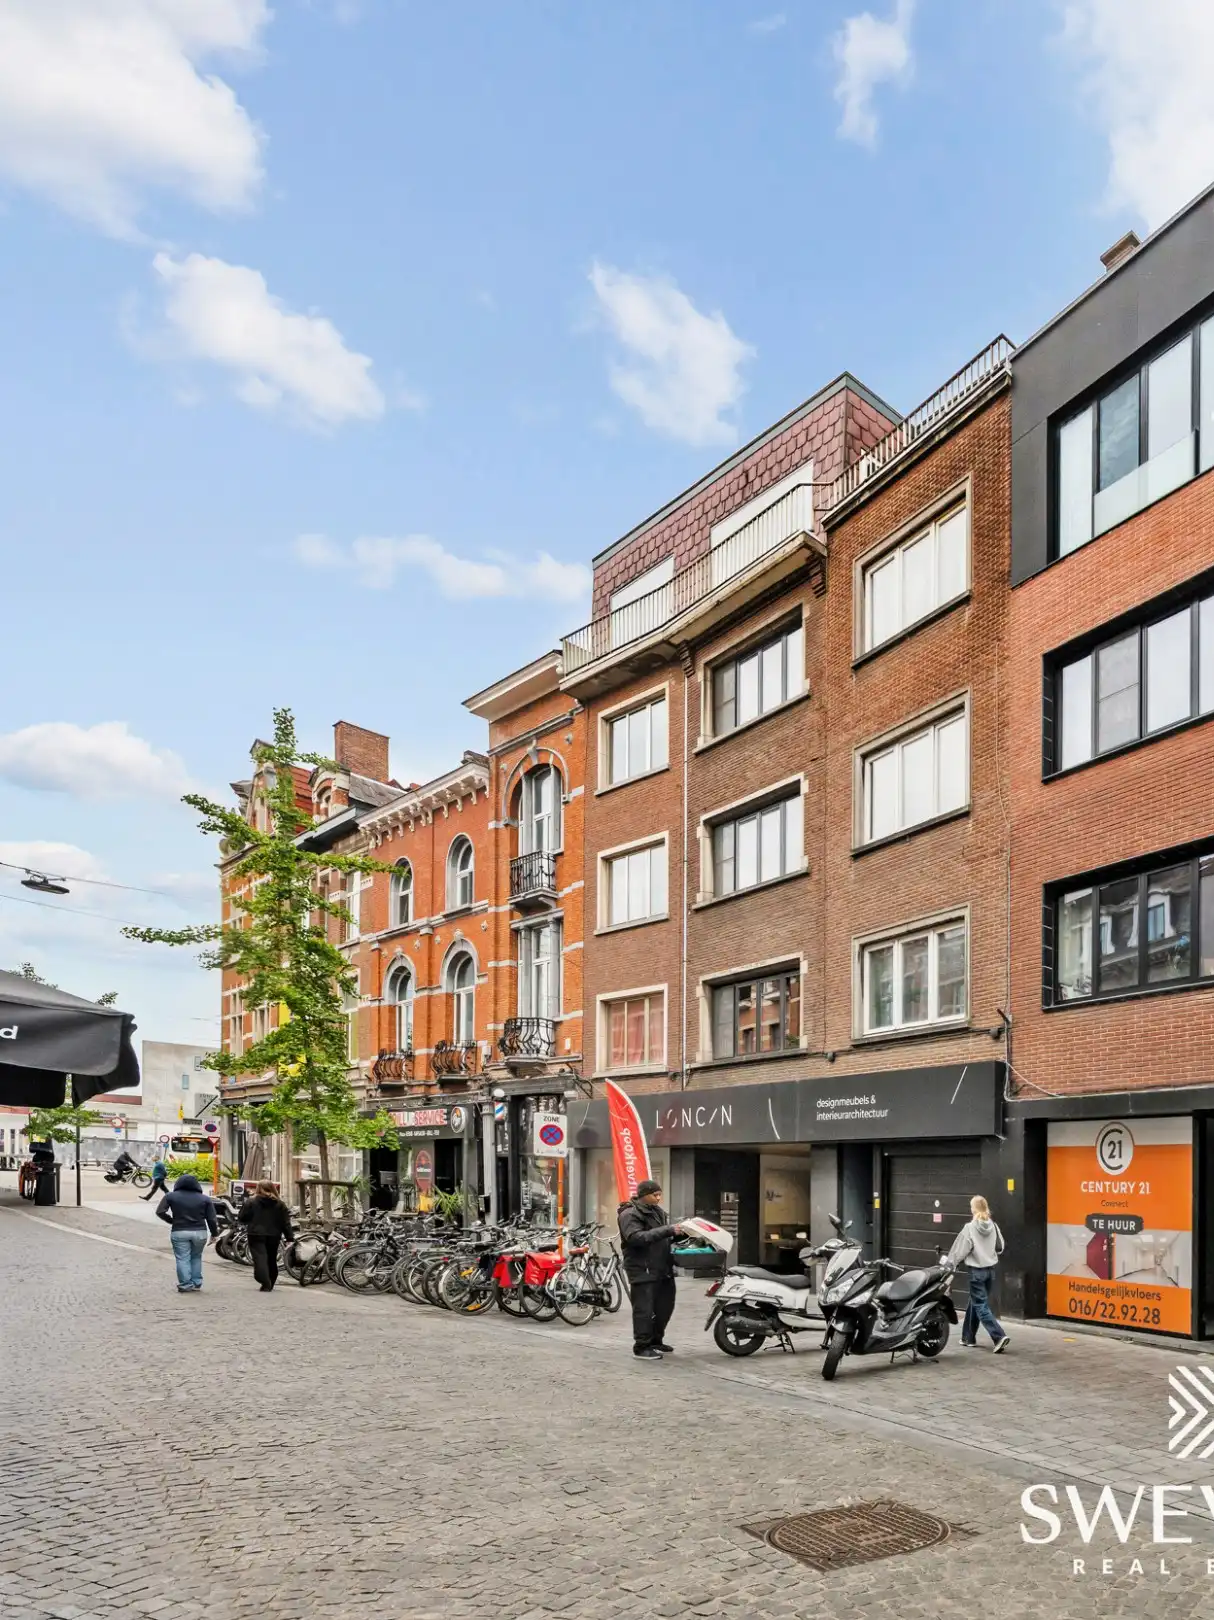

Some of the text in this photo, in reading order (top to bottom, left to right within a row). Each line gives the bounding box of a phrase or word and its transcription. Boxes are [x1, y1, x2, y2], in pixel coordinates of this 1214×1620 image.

[816, 1094, 876, 1109] designmeubels &
[816, 1109, 889, 1121] interieurarchitectuur
[1081, 1181, 1151, 1195] CENTURY 21
[1092, 1219, 1136, 1231] TE HUUR
[1068, 1281, 1162, 1301] Handelsgelijkvloers
[1068, 1297, 1161, 1325] 016/22.92.28
